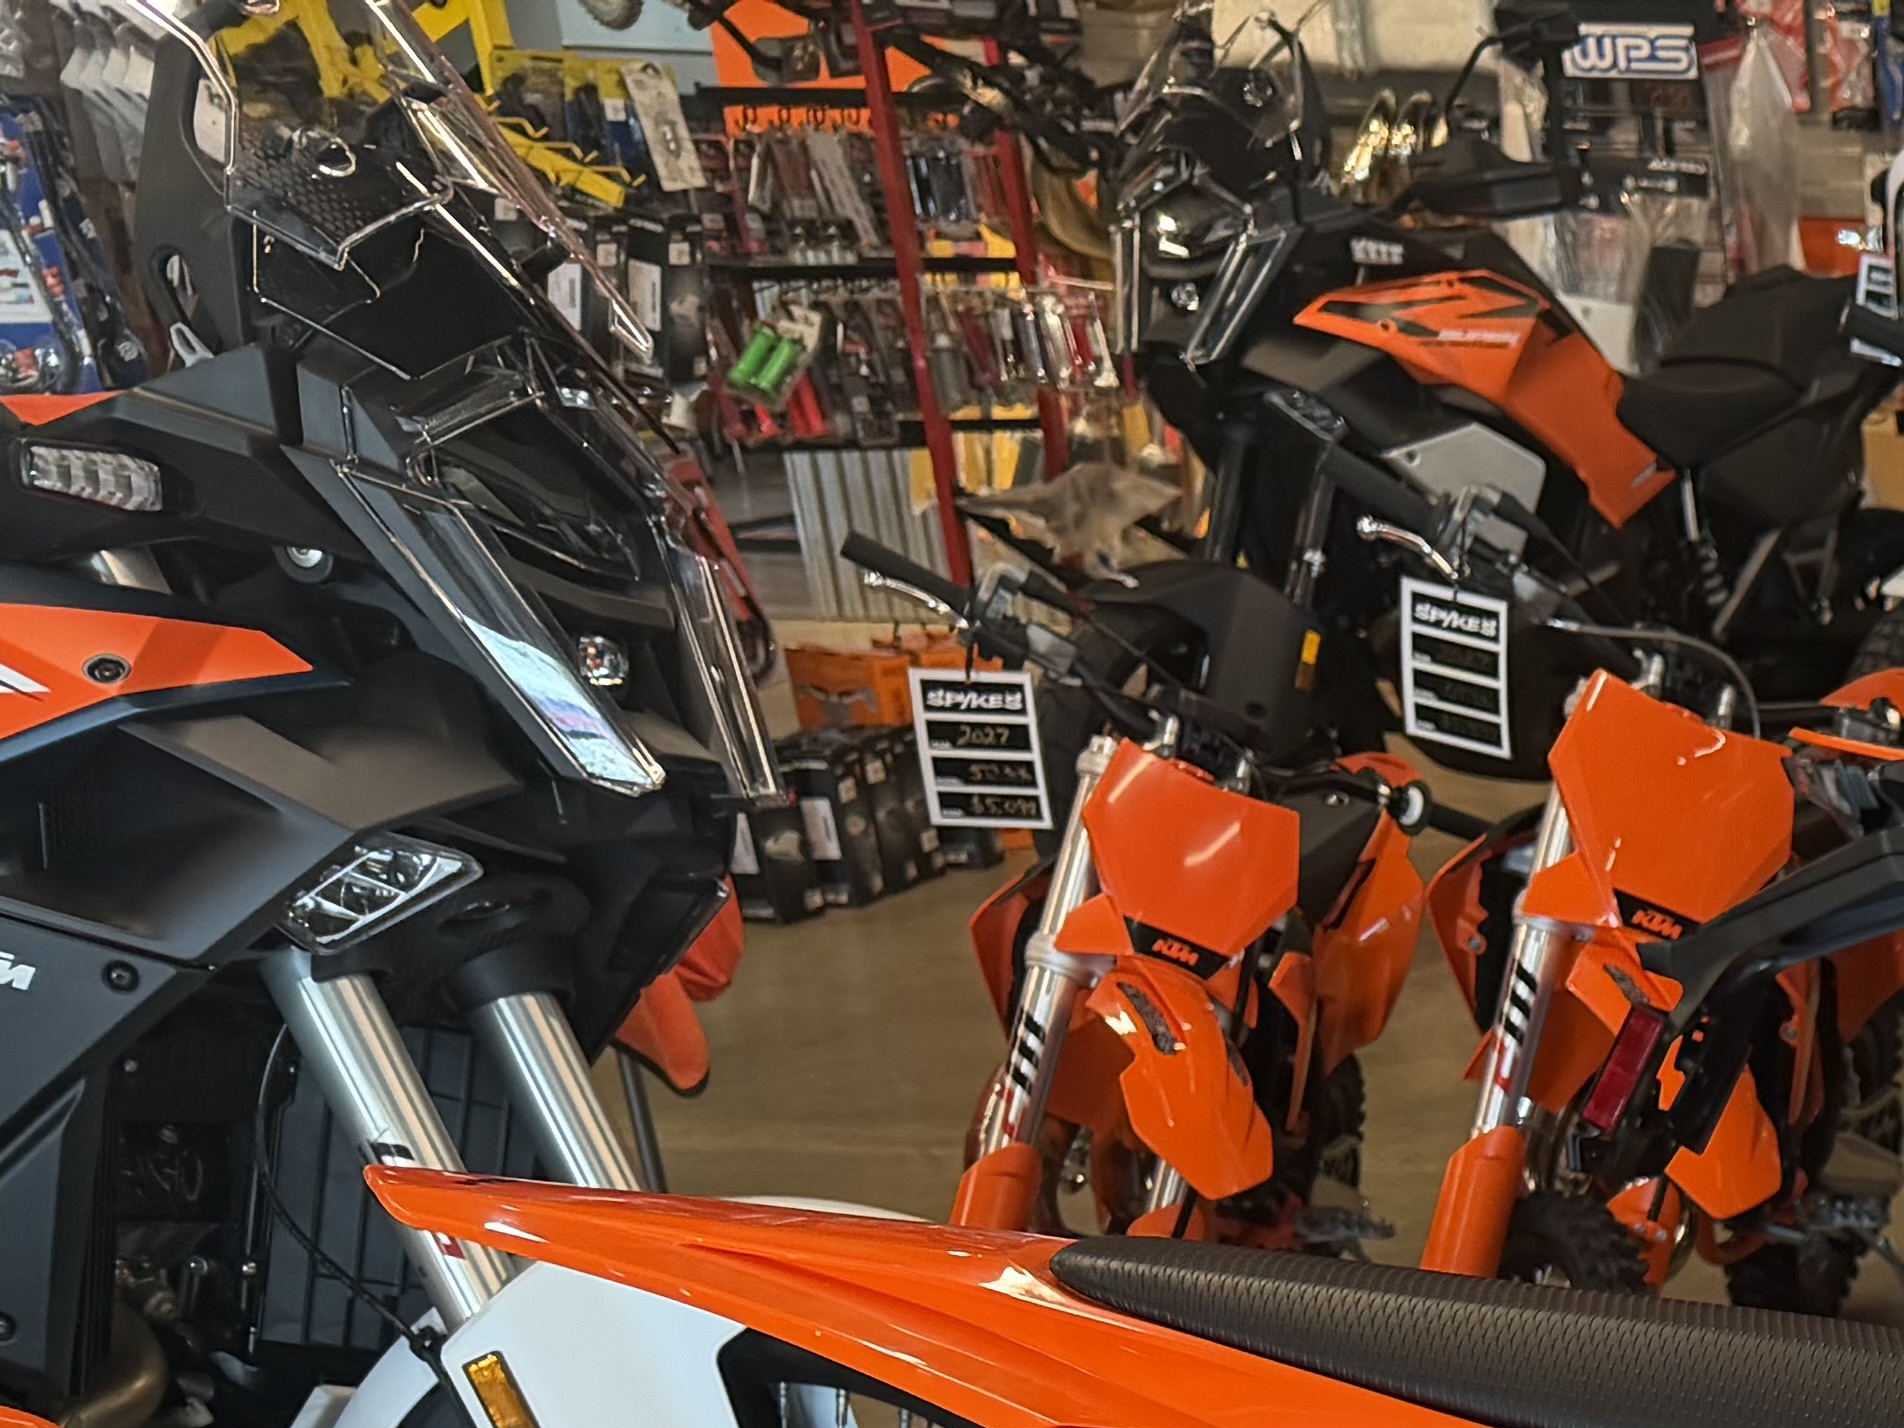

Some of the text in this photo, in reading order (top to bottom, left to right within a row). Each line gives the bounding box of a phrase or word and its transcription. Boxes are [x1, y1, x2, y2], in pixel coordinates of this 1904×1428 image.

[1572, 35, 1690, 72] WPS
[1632, 909, 1684, 942] KTM
[1151, 937, 1200, 967] KTM
